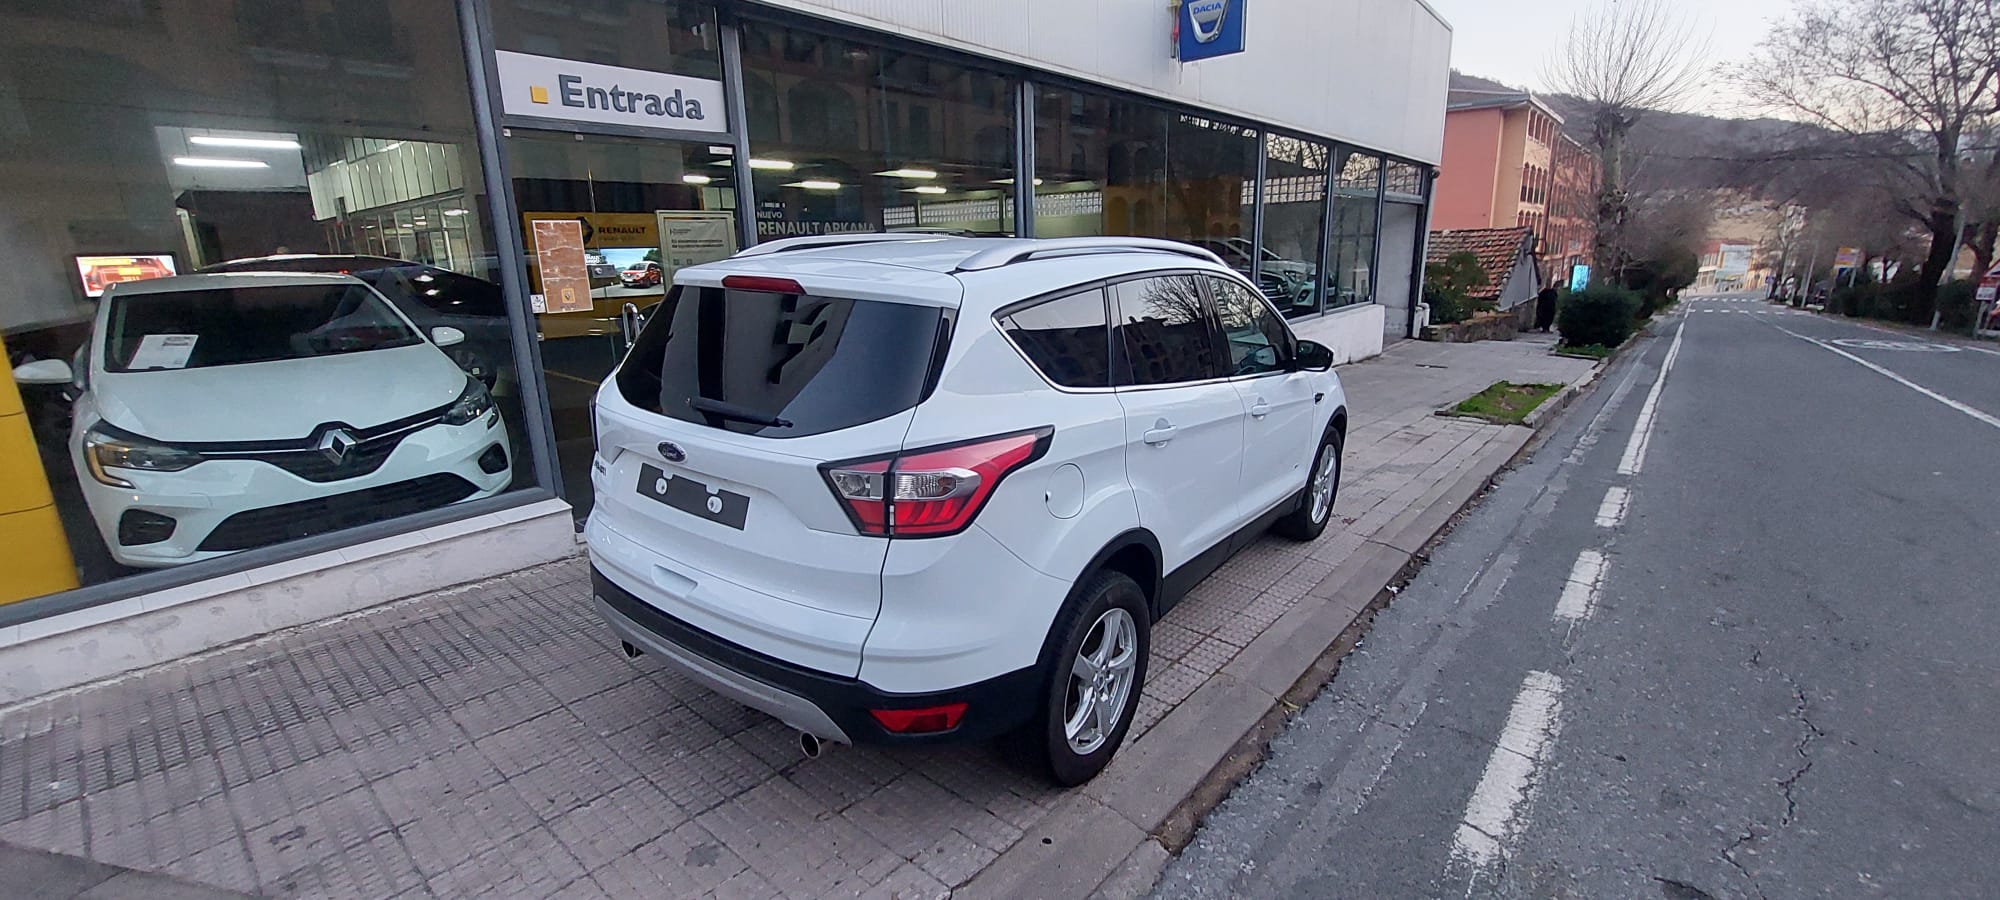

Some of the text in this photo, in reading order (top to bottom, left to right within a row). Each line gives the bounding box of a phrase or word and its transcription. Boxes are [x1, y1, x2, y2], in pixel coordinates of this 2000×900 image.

[1193, 2, 1222, 15] DACIA
[558, 74, 705, 121] Entrada
[756, 211, 783, 219] NUEVO
[598, 226, 646, 234] RENAULT
[758, 221, 876, 235] RENAULT ARKANA
